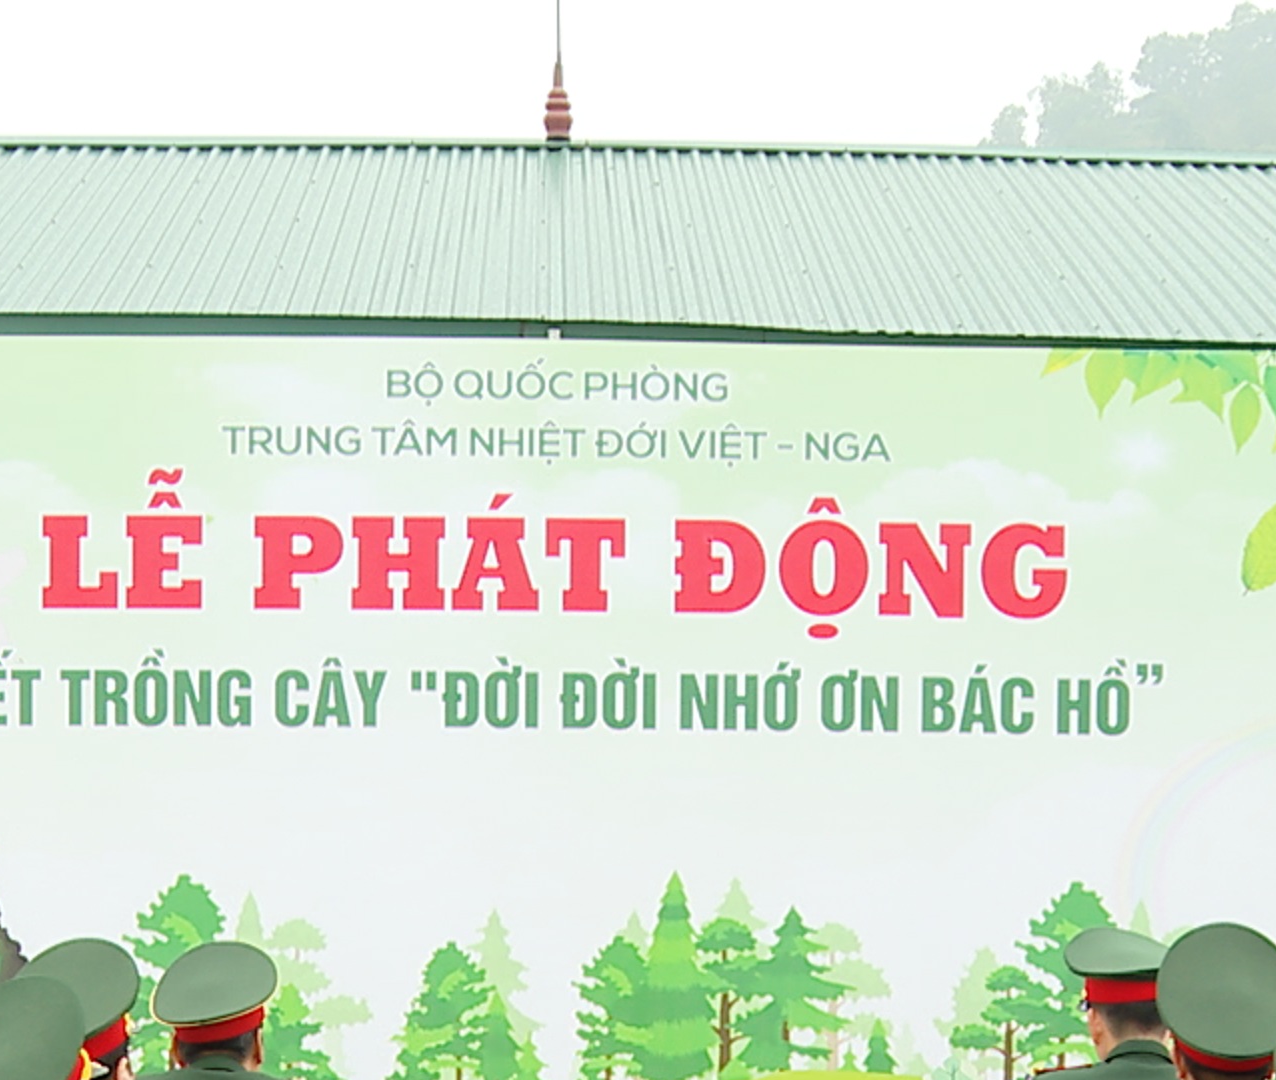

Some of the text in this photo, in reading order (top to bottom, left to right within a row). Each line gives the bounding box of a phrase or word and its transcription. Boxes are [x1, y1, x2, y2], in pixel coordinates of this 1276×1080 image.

[386, 358, 728, 406] BỘ QUỐC PHÒNG
[222, 425, 361, 455] TRUNG
[371, 419, 458, 457] TÂM
[470, 420, 586, 465] NHIỆT
[595, 421, 666, 458] ĐỚI
[678, 423, 767, 467] VIỆT
[805, 432, 891, 462] NGA
[42, 469, 1068, 639] LỄ PHÁT ĐỘNG
[59, 649, 252, 728] TRỒNG
[275, 657, 388, 728] CÂY
[559, 658, 657, 730] ĐỜI
[679, 661, 802, 731] NHỚ
[820, 670, 900, 732] ƠN
[921, 664, 1035, 734] BÁC
